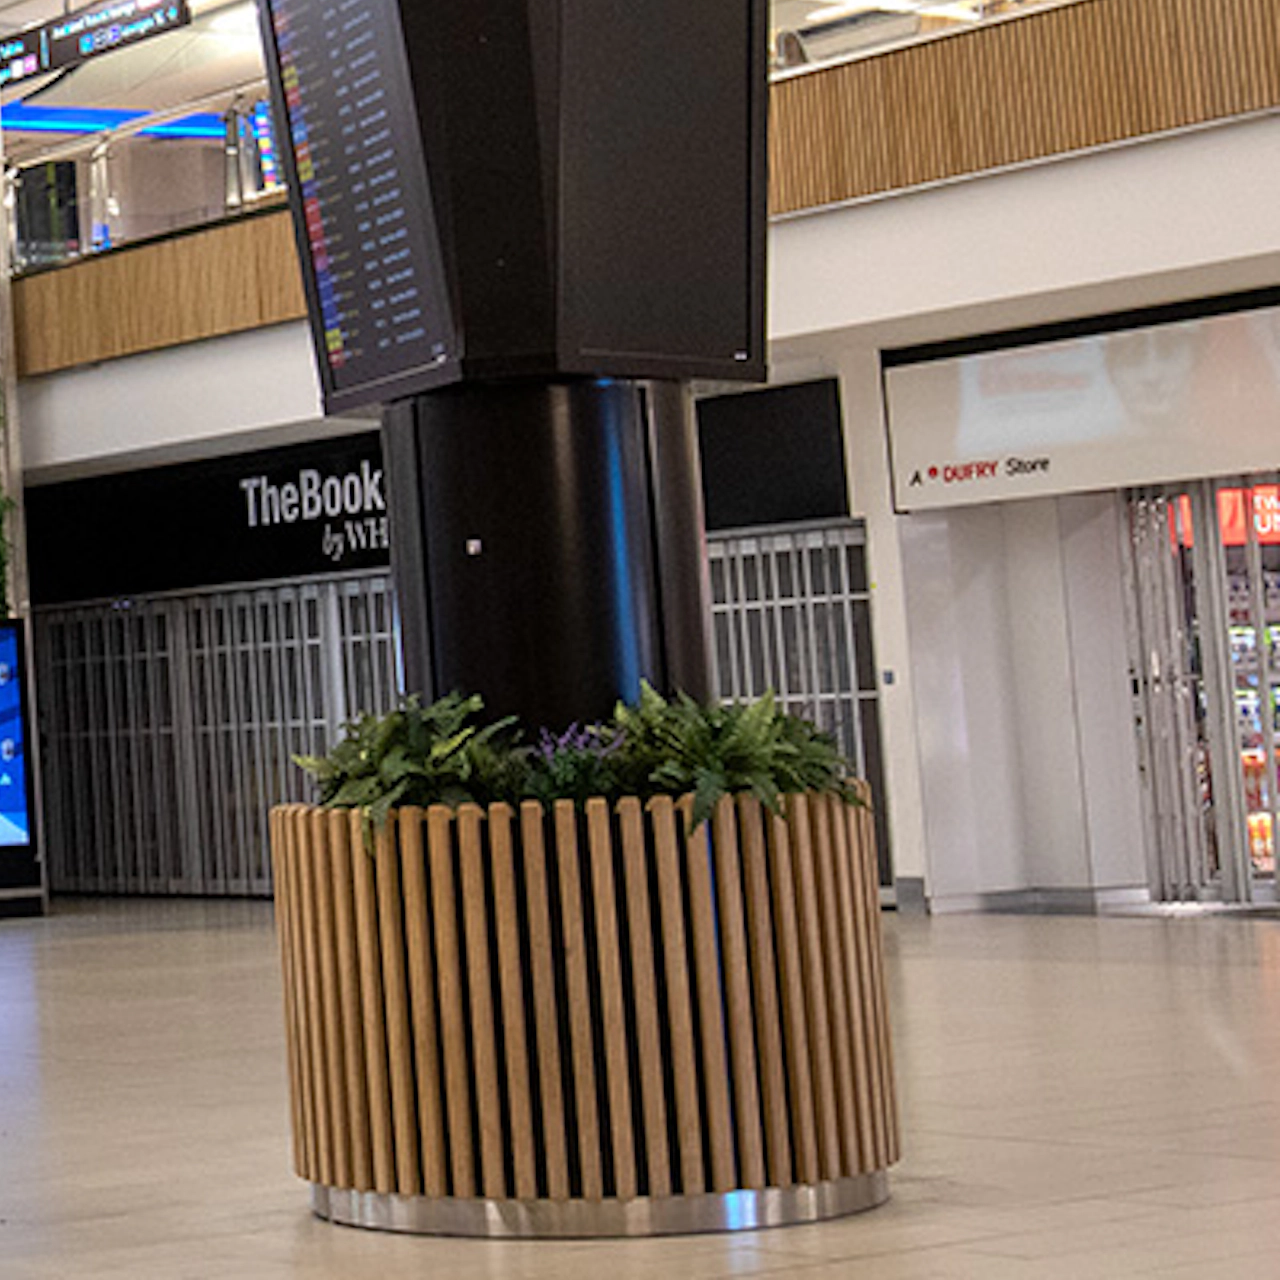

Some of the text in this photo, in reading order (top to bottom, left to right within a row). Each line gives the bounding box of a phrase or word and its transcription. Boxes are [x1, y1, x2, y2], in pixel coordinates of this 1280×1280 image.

[910, 457, 1049, 487] A DUFRY Store
[239, 459, 386, 527] TheBook
[322, 523, 344, 561] by
